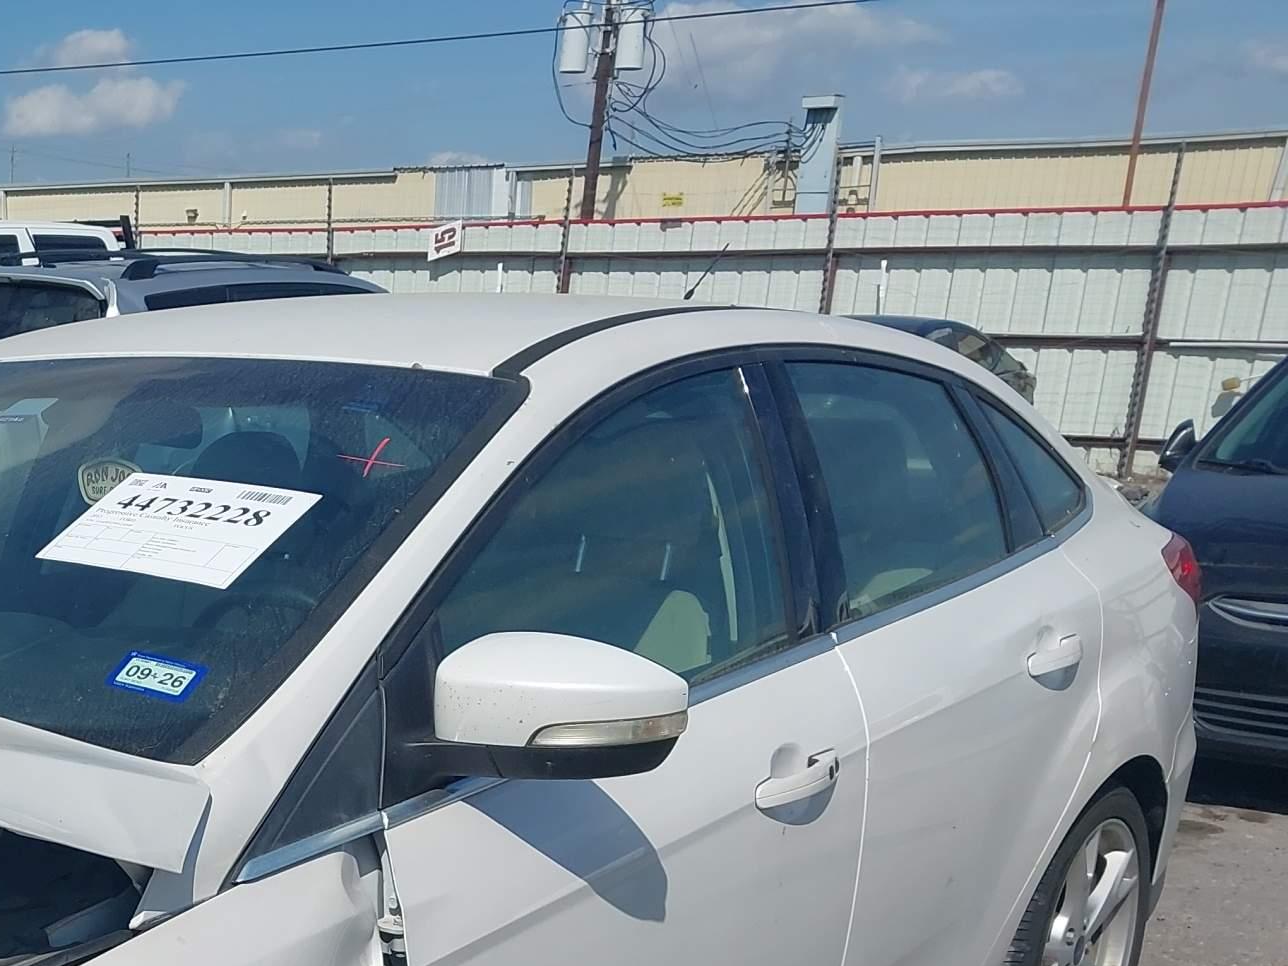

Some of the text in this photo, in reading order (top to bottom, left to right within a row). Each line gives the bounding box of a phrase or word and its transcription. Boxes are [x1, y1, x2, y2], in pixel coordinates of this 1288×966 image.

[434, 227, 456, 254] 15
[86, 467, 132, 486] RON JO
[91, 486, 107, 496] SURF
[96, 507, 139, 518] Progressive
[139, 512, 172, 522] Casualty
[172, 516, 211, 527] Insurance
[117, 494, 271, 527] 44732228
